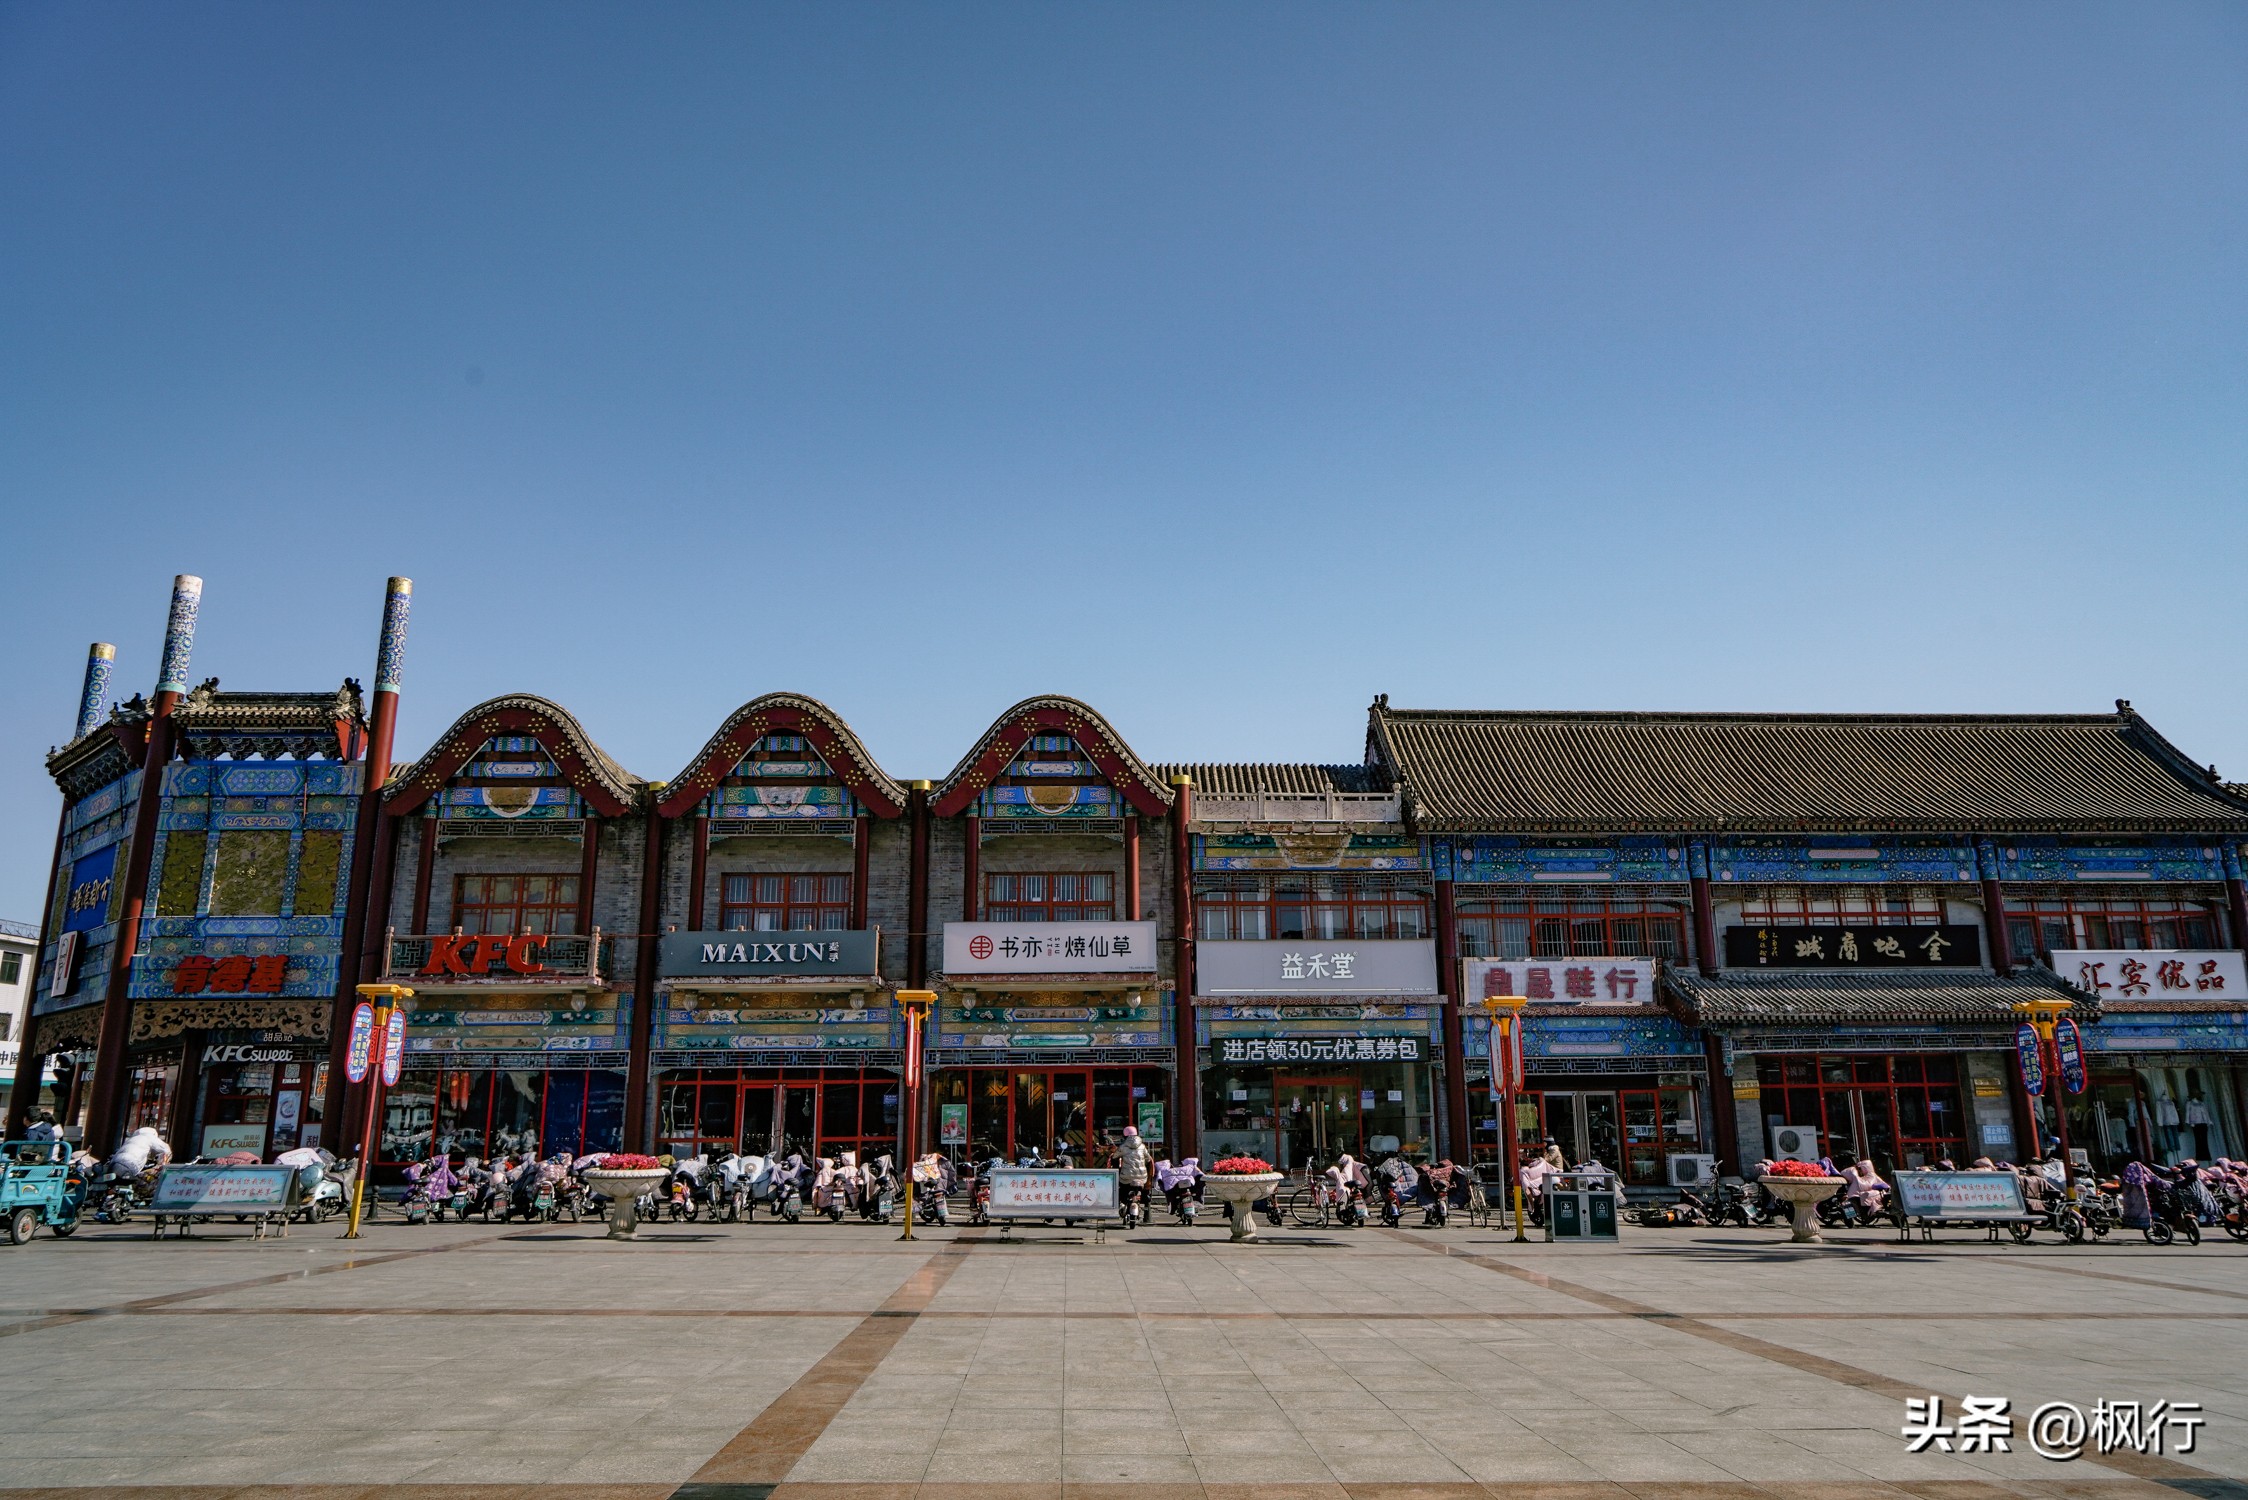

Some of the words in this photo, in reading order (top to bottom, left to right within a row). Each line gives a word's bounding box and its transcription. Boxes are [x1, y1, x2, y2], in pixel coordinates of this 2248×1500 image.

[422, 935, 548, 974] KFC
[700, 942, 827, 963] MAIXUN
[998, 936, 1043, 959] 书亦
[173, 954, 289, 994] 肯德基
[1280, 952, 1356, 980] 益禾堂
[2080, 957, 2226, 998] 汇宾优品
[1484, 965, 1639, 999] 鼎晟鞋行
[1223, 1037, 1419, 1061] 进店领30元优惠券包
